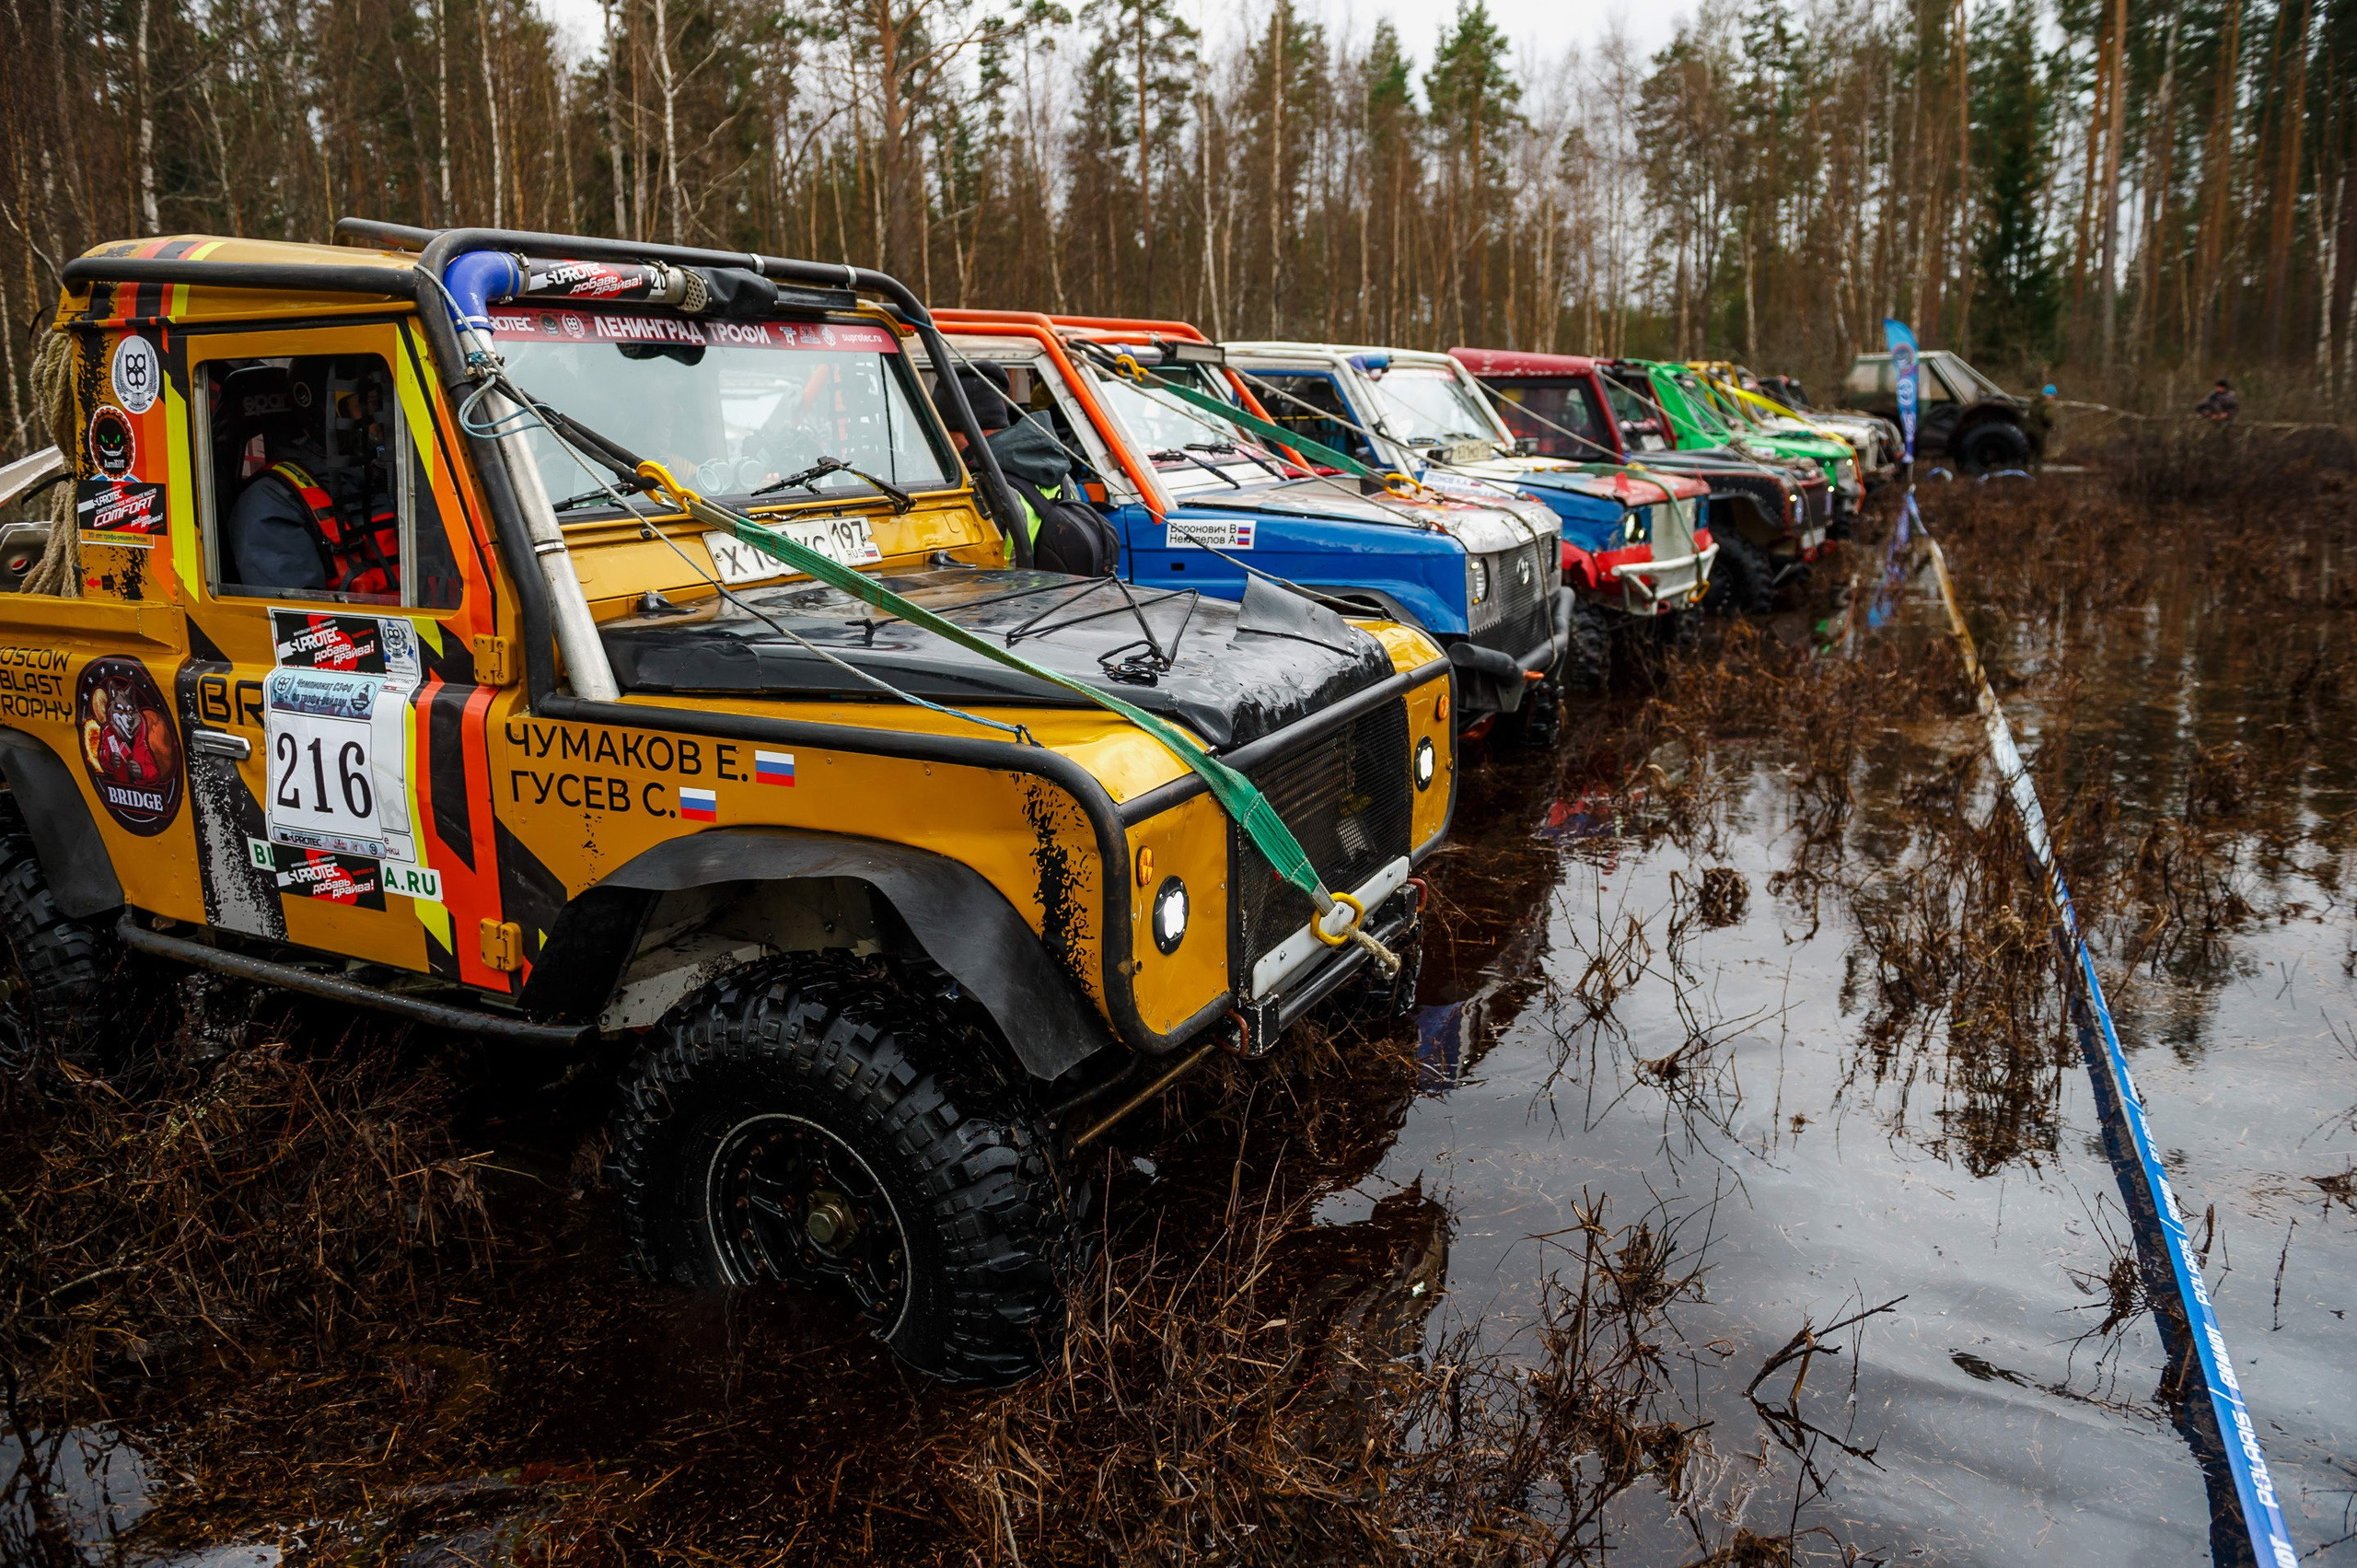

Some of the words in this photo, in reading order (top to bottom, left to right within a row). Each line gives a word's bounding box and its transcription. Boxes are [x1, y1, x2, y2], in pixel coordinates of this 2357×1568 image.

[547, 262, 607, 285] SUPROTEC
[489, 316, 535, 331] ROTEC
[594, 316, 706, 345] ЛЕНИНГРАД
[705, 322, 772, 344] ТРОФИ
[842, 332, 882, 343] suprotec.ru
[93, 494, 157, 528] COMFORT
[831, 521, 865, 550] 197
[1227, 535, 1237, 544] А
[1229, 524, 1237, 534] В
[845, 549, 865, 560] RUS
[291, 627, 342, 653] SUPROTEC
[314, 643, 352, 663] добавь
[333, 640, 375, 666] драйва!
[0, 646, 72, 672] OSCOW
[0, 668, 63, 696] BLAST
[296, 679, 334, 691] Чемпионат
[0, 694, 73, 722] ROPHY
[199, 676, 264, 728] BR
[505, 723, 703, 775] ЧУМАКОВ
[716, 744, 749, 783] Е.
[276, 732, 373, 819] 216
[108, 786, 164, 811] BRIDGE
[510, 770, 632, 812] ГУСЕВ
[642, 782, 677, 819] С.
[288, 833, 321, 847] SUPROTEC
[253, 843, 275, 866] BL
[385, 867, 437, 896] A.RU
[289, 863, 341, 883] SUPROTEC
[312, 878, 351, 895] добавь
[332, 878, 375, 899] драйва!
[2178, 1237, 2212, 1307] POLARIS
[2204, 1321, 2240, 1391] BRANDT
[2232, 1410, 2279, 1508] POLARIS
